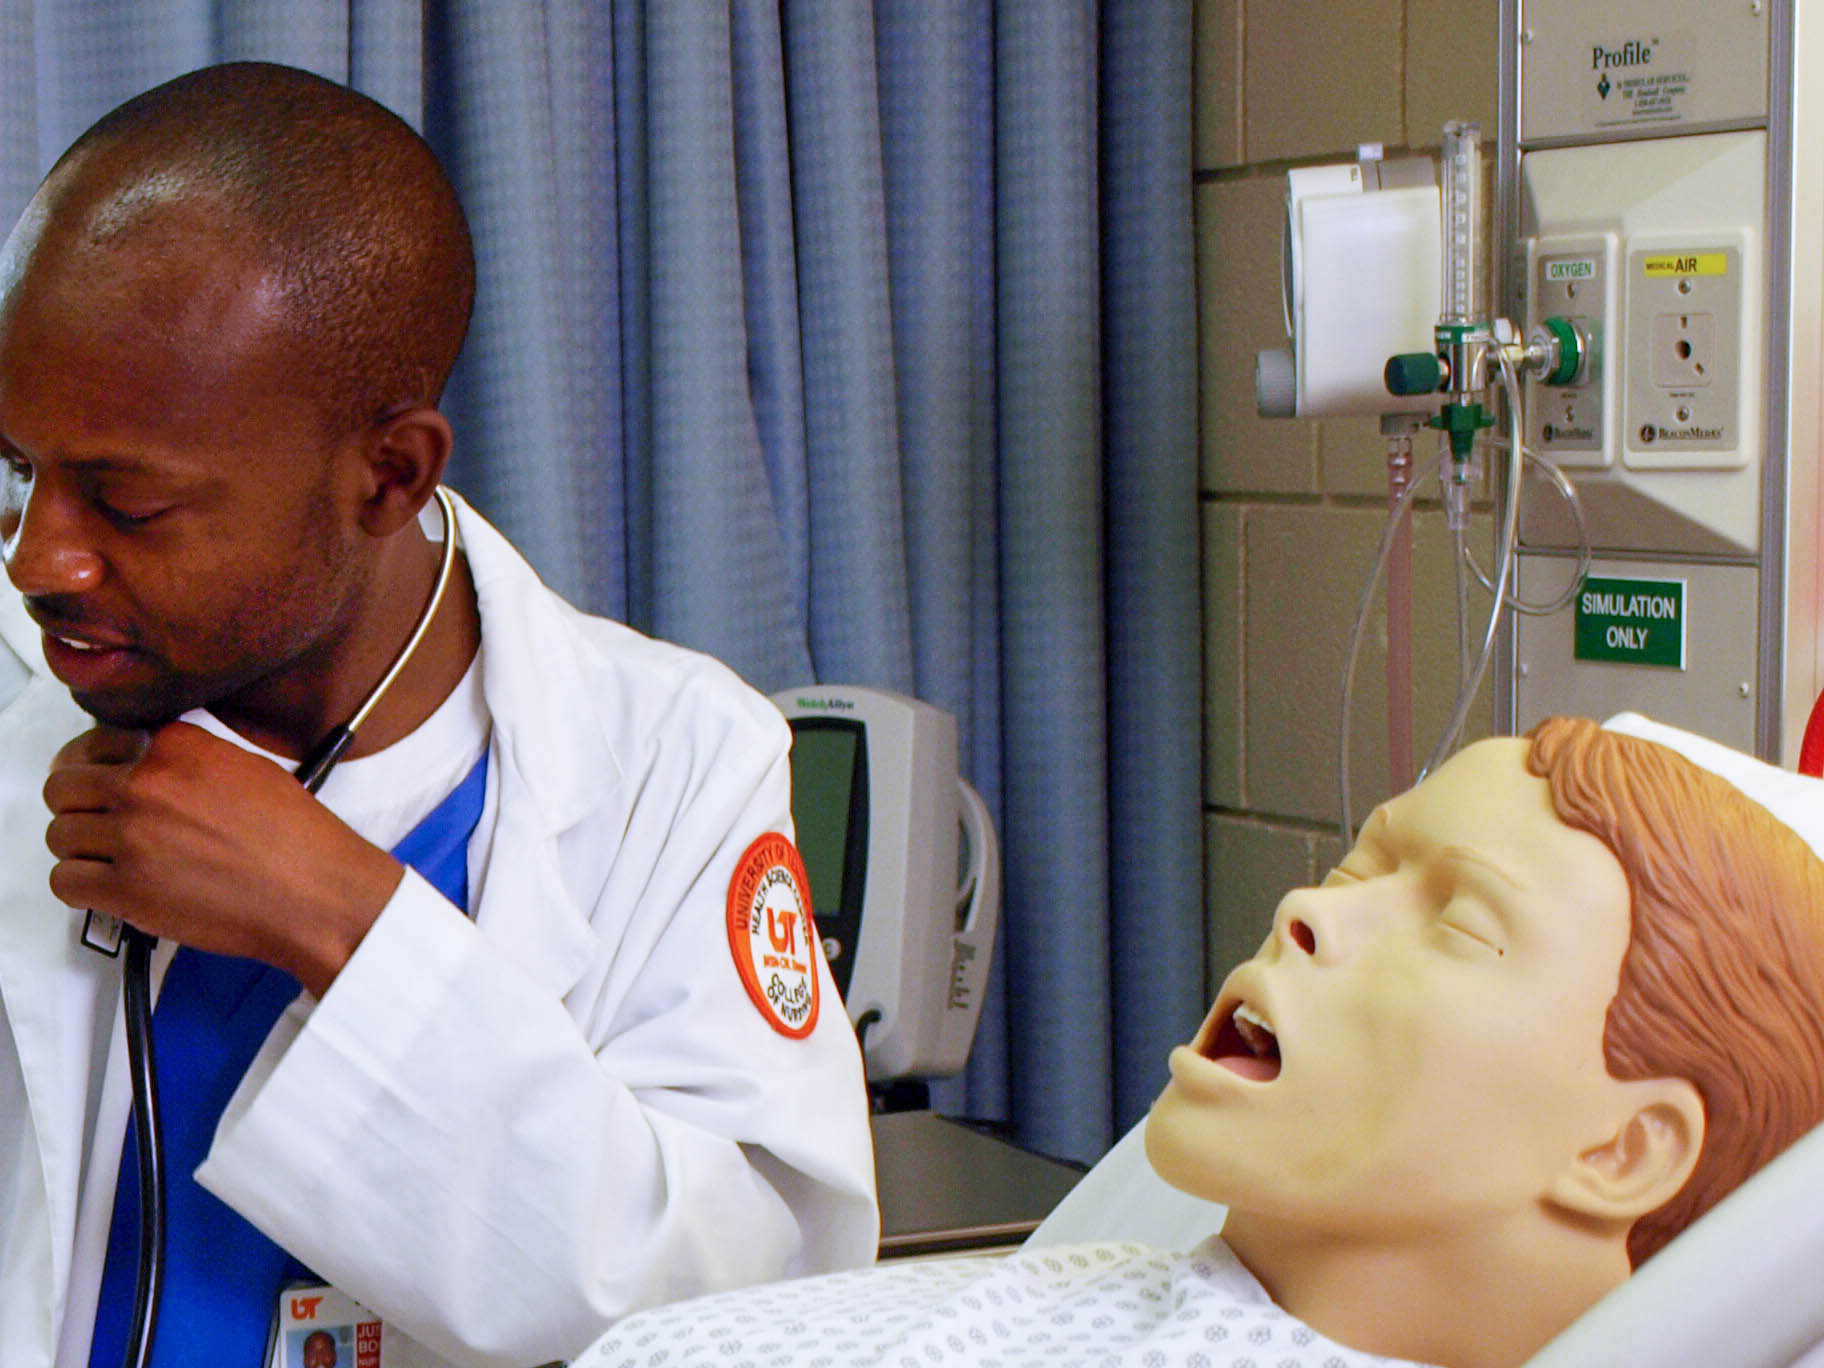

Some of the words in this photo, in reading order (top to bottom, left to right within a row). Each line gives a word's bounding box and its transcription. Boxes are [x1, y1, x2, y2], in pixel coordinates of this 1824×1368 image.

[1550, 262, 1592, 278] OXYGEN
[1675, 257, 1697, 273] AIR
[1581, 592, 1676, 620] SIMULATION
[1606, 625, 1648, 650] ONLY
[736, 844, 774, 931] UNIVERSITY
[751, 882, 768, 936] HEALTH
[766, 906, 797, 956] UT
[291, 1296, 324, 1320] UT
